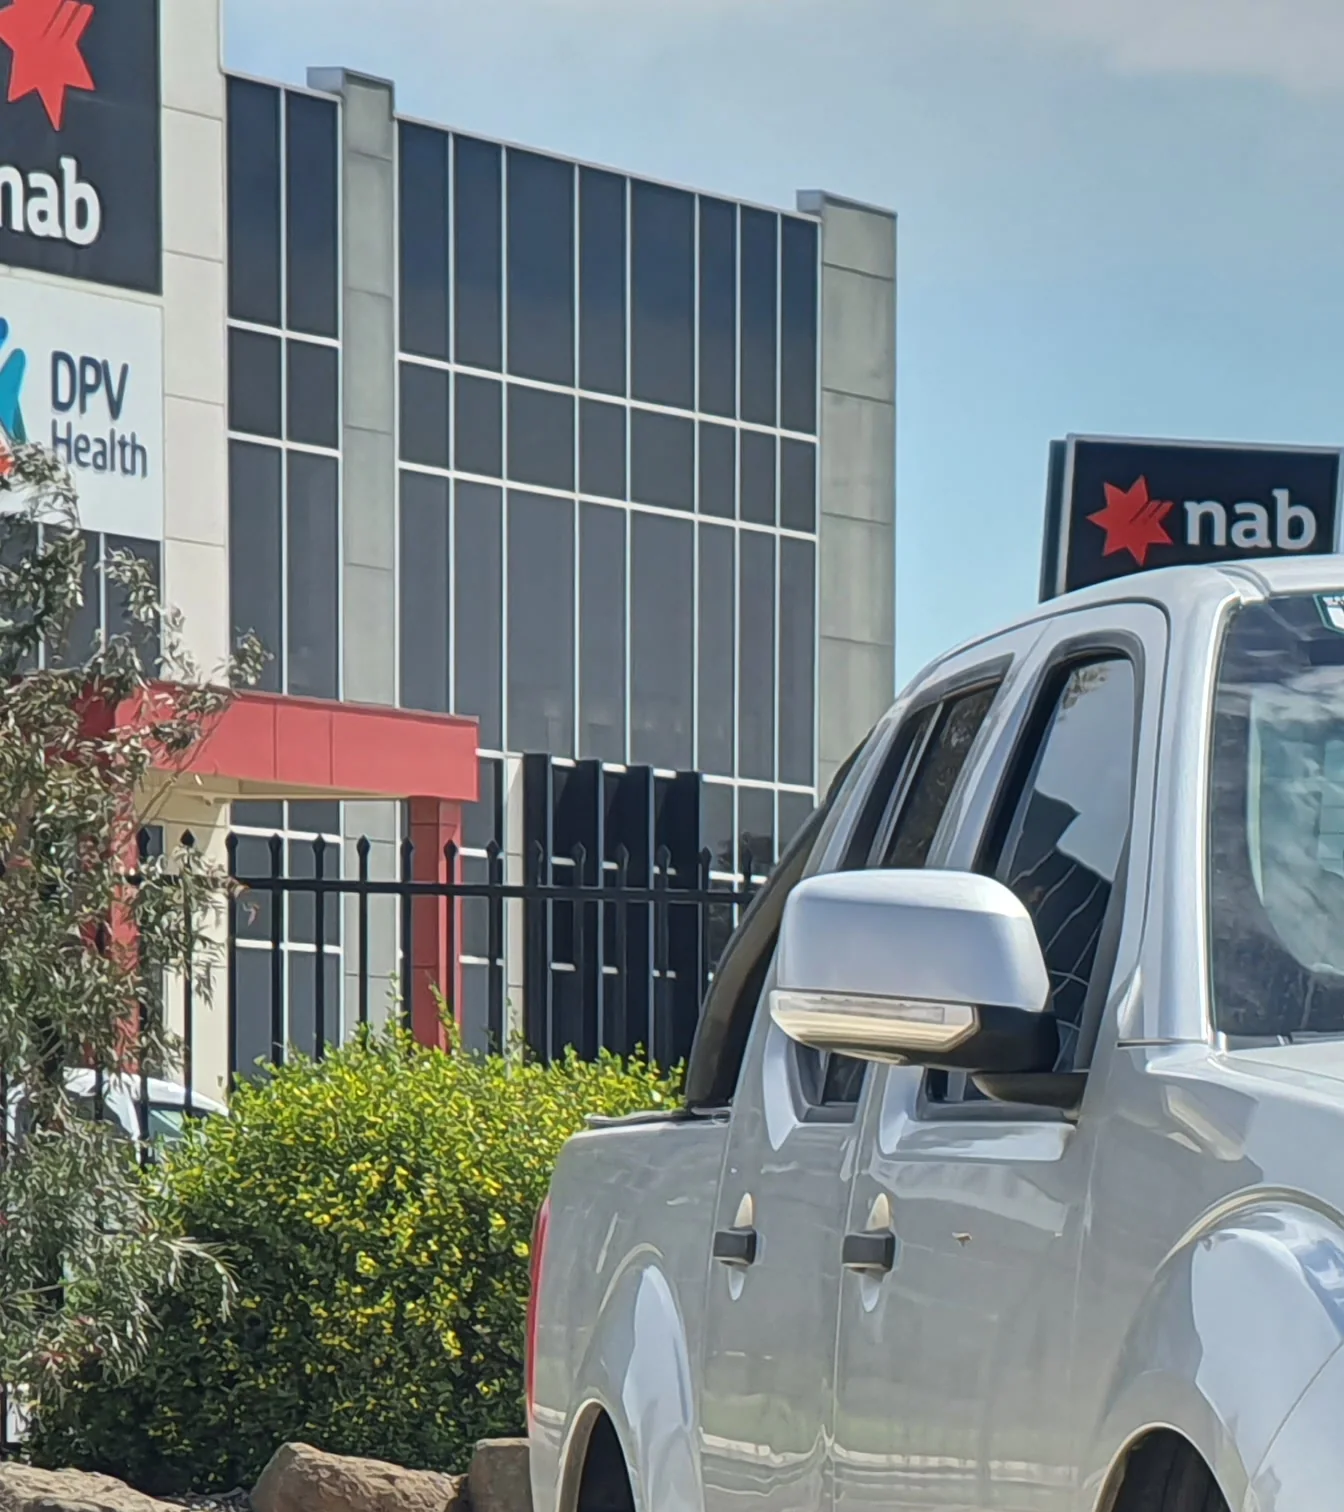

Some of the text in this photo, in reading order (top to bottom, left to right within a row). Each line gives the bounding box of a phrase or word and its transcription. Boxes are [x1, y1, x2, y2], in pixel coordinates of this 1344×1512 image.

[0, 156, 100, 246] nab
[52, 350, 129, 421] DPV
[52, 418, 148, 479] Health
[1184, 488, 1317, 550] nab
